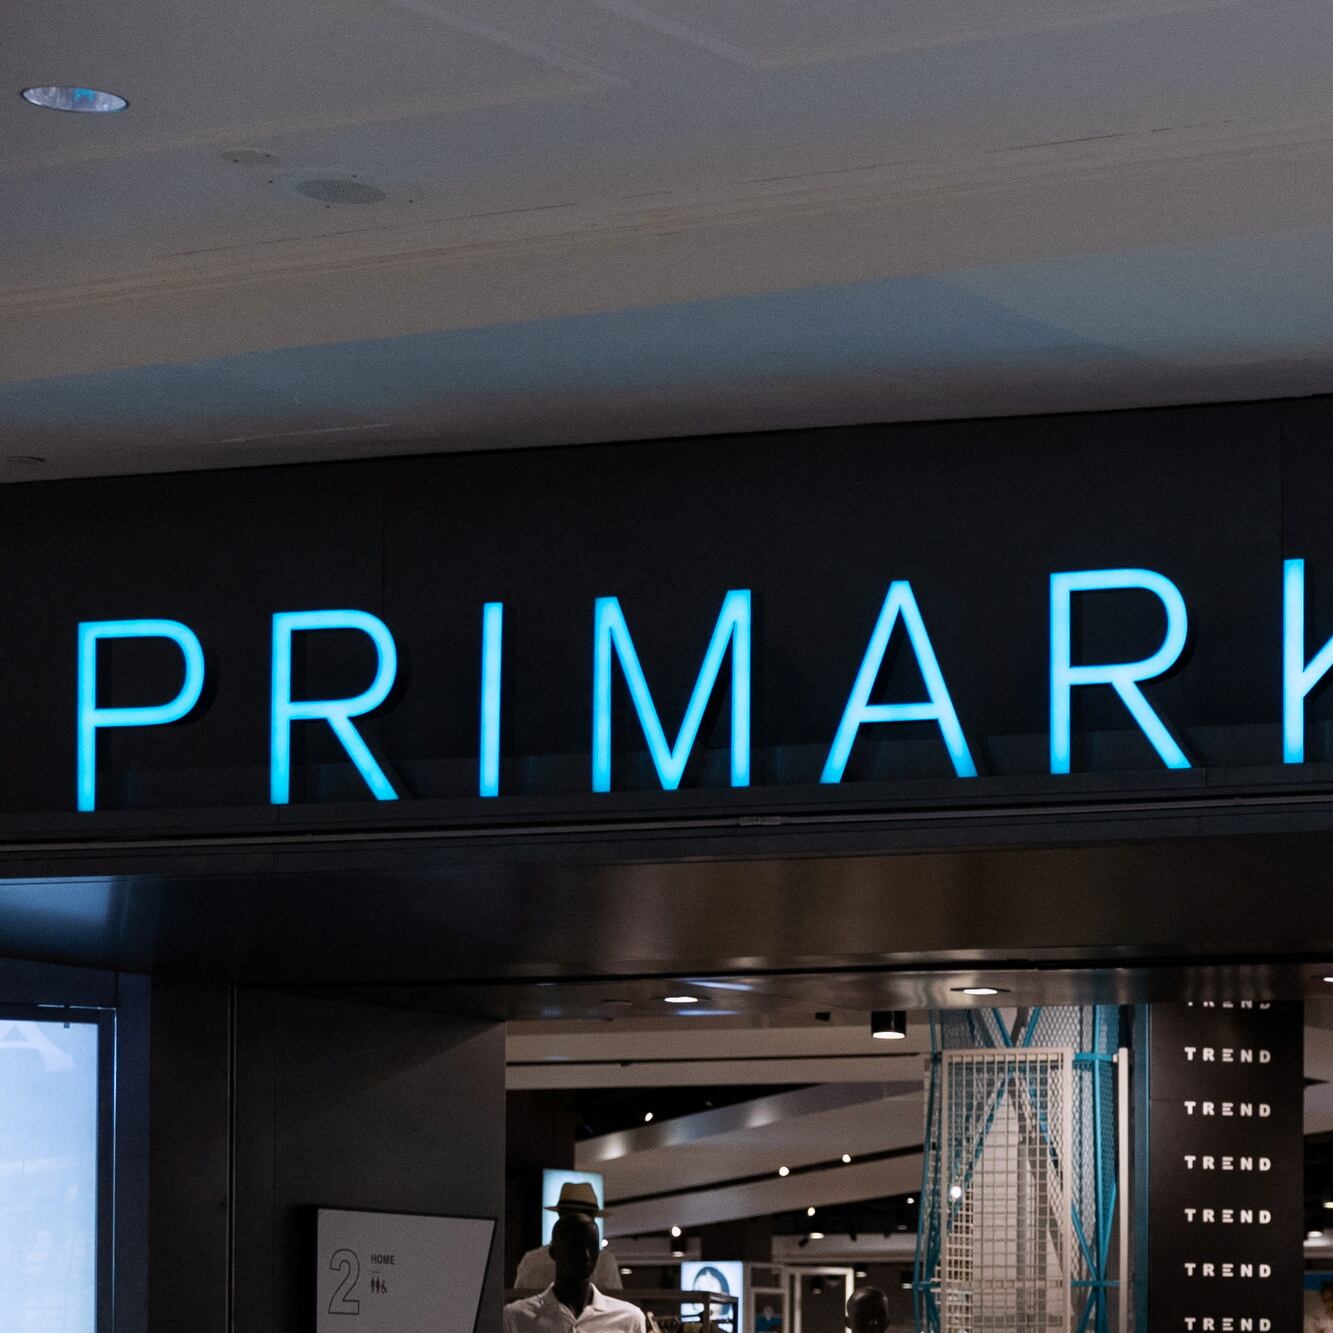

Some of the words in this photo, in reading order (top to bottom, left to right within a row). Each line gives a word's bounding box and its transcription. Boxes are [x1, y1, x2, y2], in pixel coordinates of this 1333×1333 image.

[1184, 1047, 1271, 1063] TREND
[1184, 1101, 1271, 1117] TREND
[1184, 1155, 1272, 1171] TREND
[1184, 1209, 1272, 1224] TREND
[371, 1254, 396, 1265] HOME
[1184, 1263, 1272, 1278] TREND
[328, 1248, 361, 1316] 2
[1184, 1318, 1271, 1331] TREND
